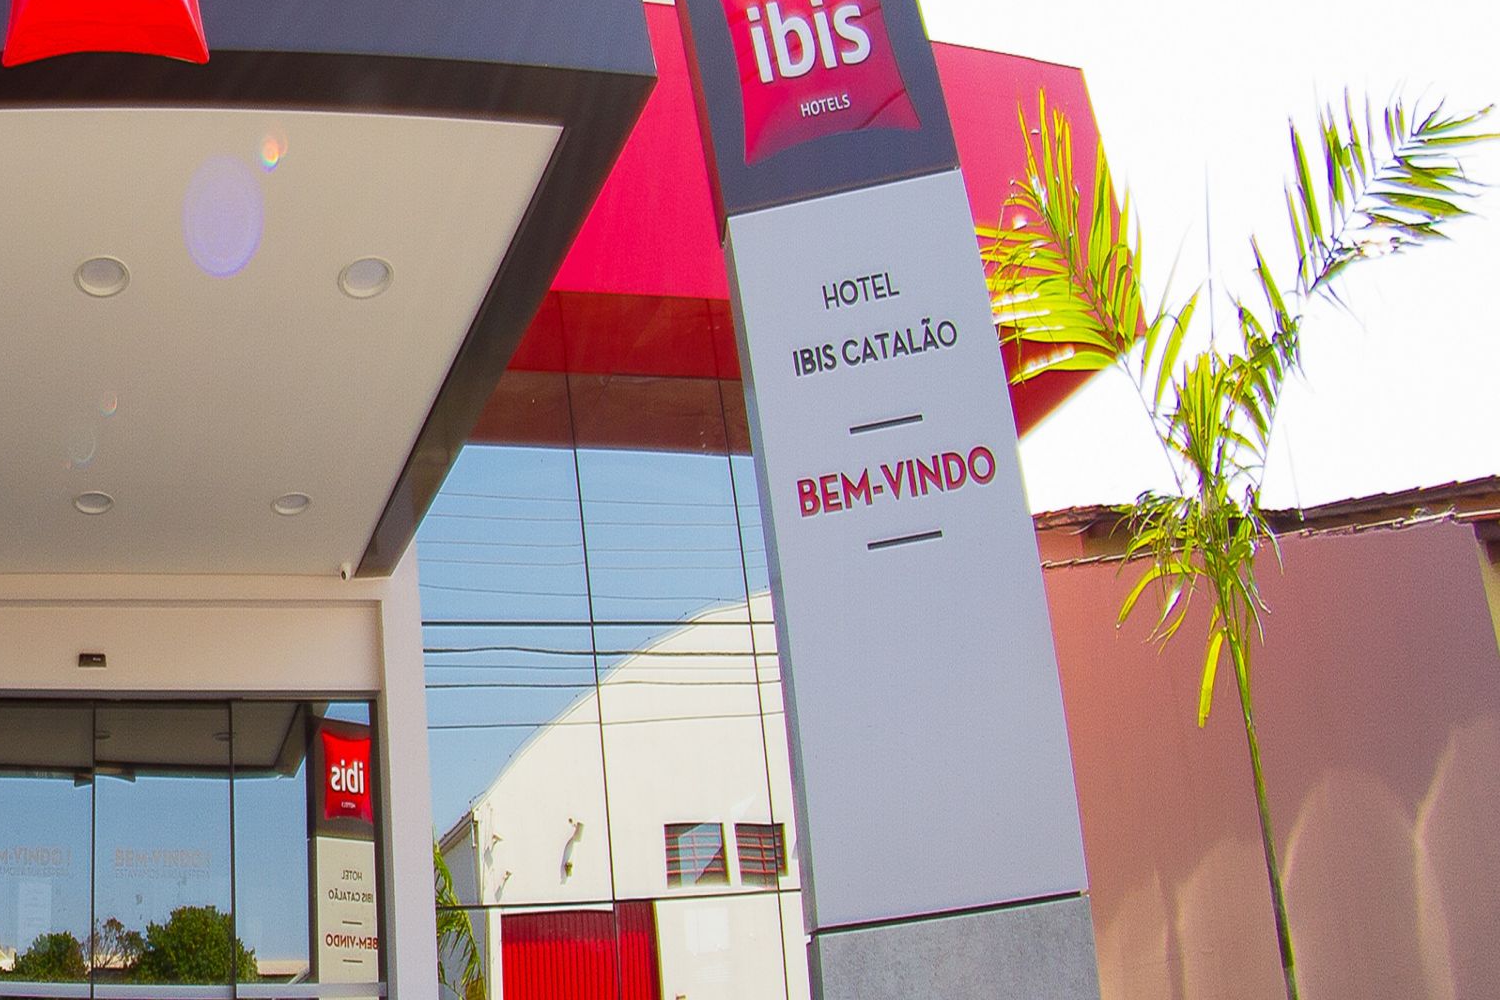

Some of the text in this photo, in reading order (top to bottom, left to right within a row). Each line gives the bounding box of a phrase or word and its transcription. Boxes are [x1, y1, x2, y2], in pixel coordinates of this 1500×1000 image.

[800, 94, 851, 118] HOTELS
[821, 272, 900, 310] HOTEL
[792, 317, 958, 377] IBIS CATALÃO
[796, 445, 996, 518] BEM-VINDO
